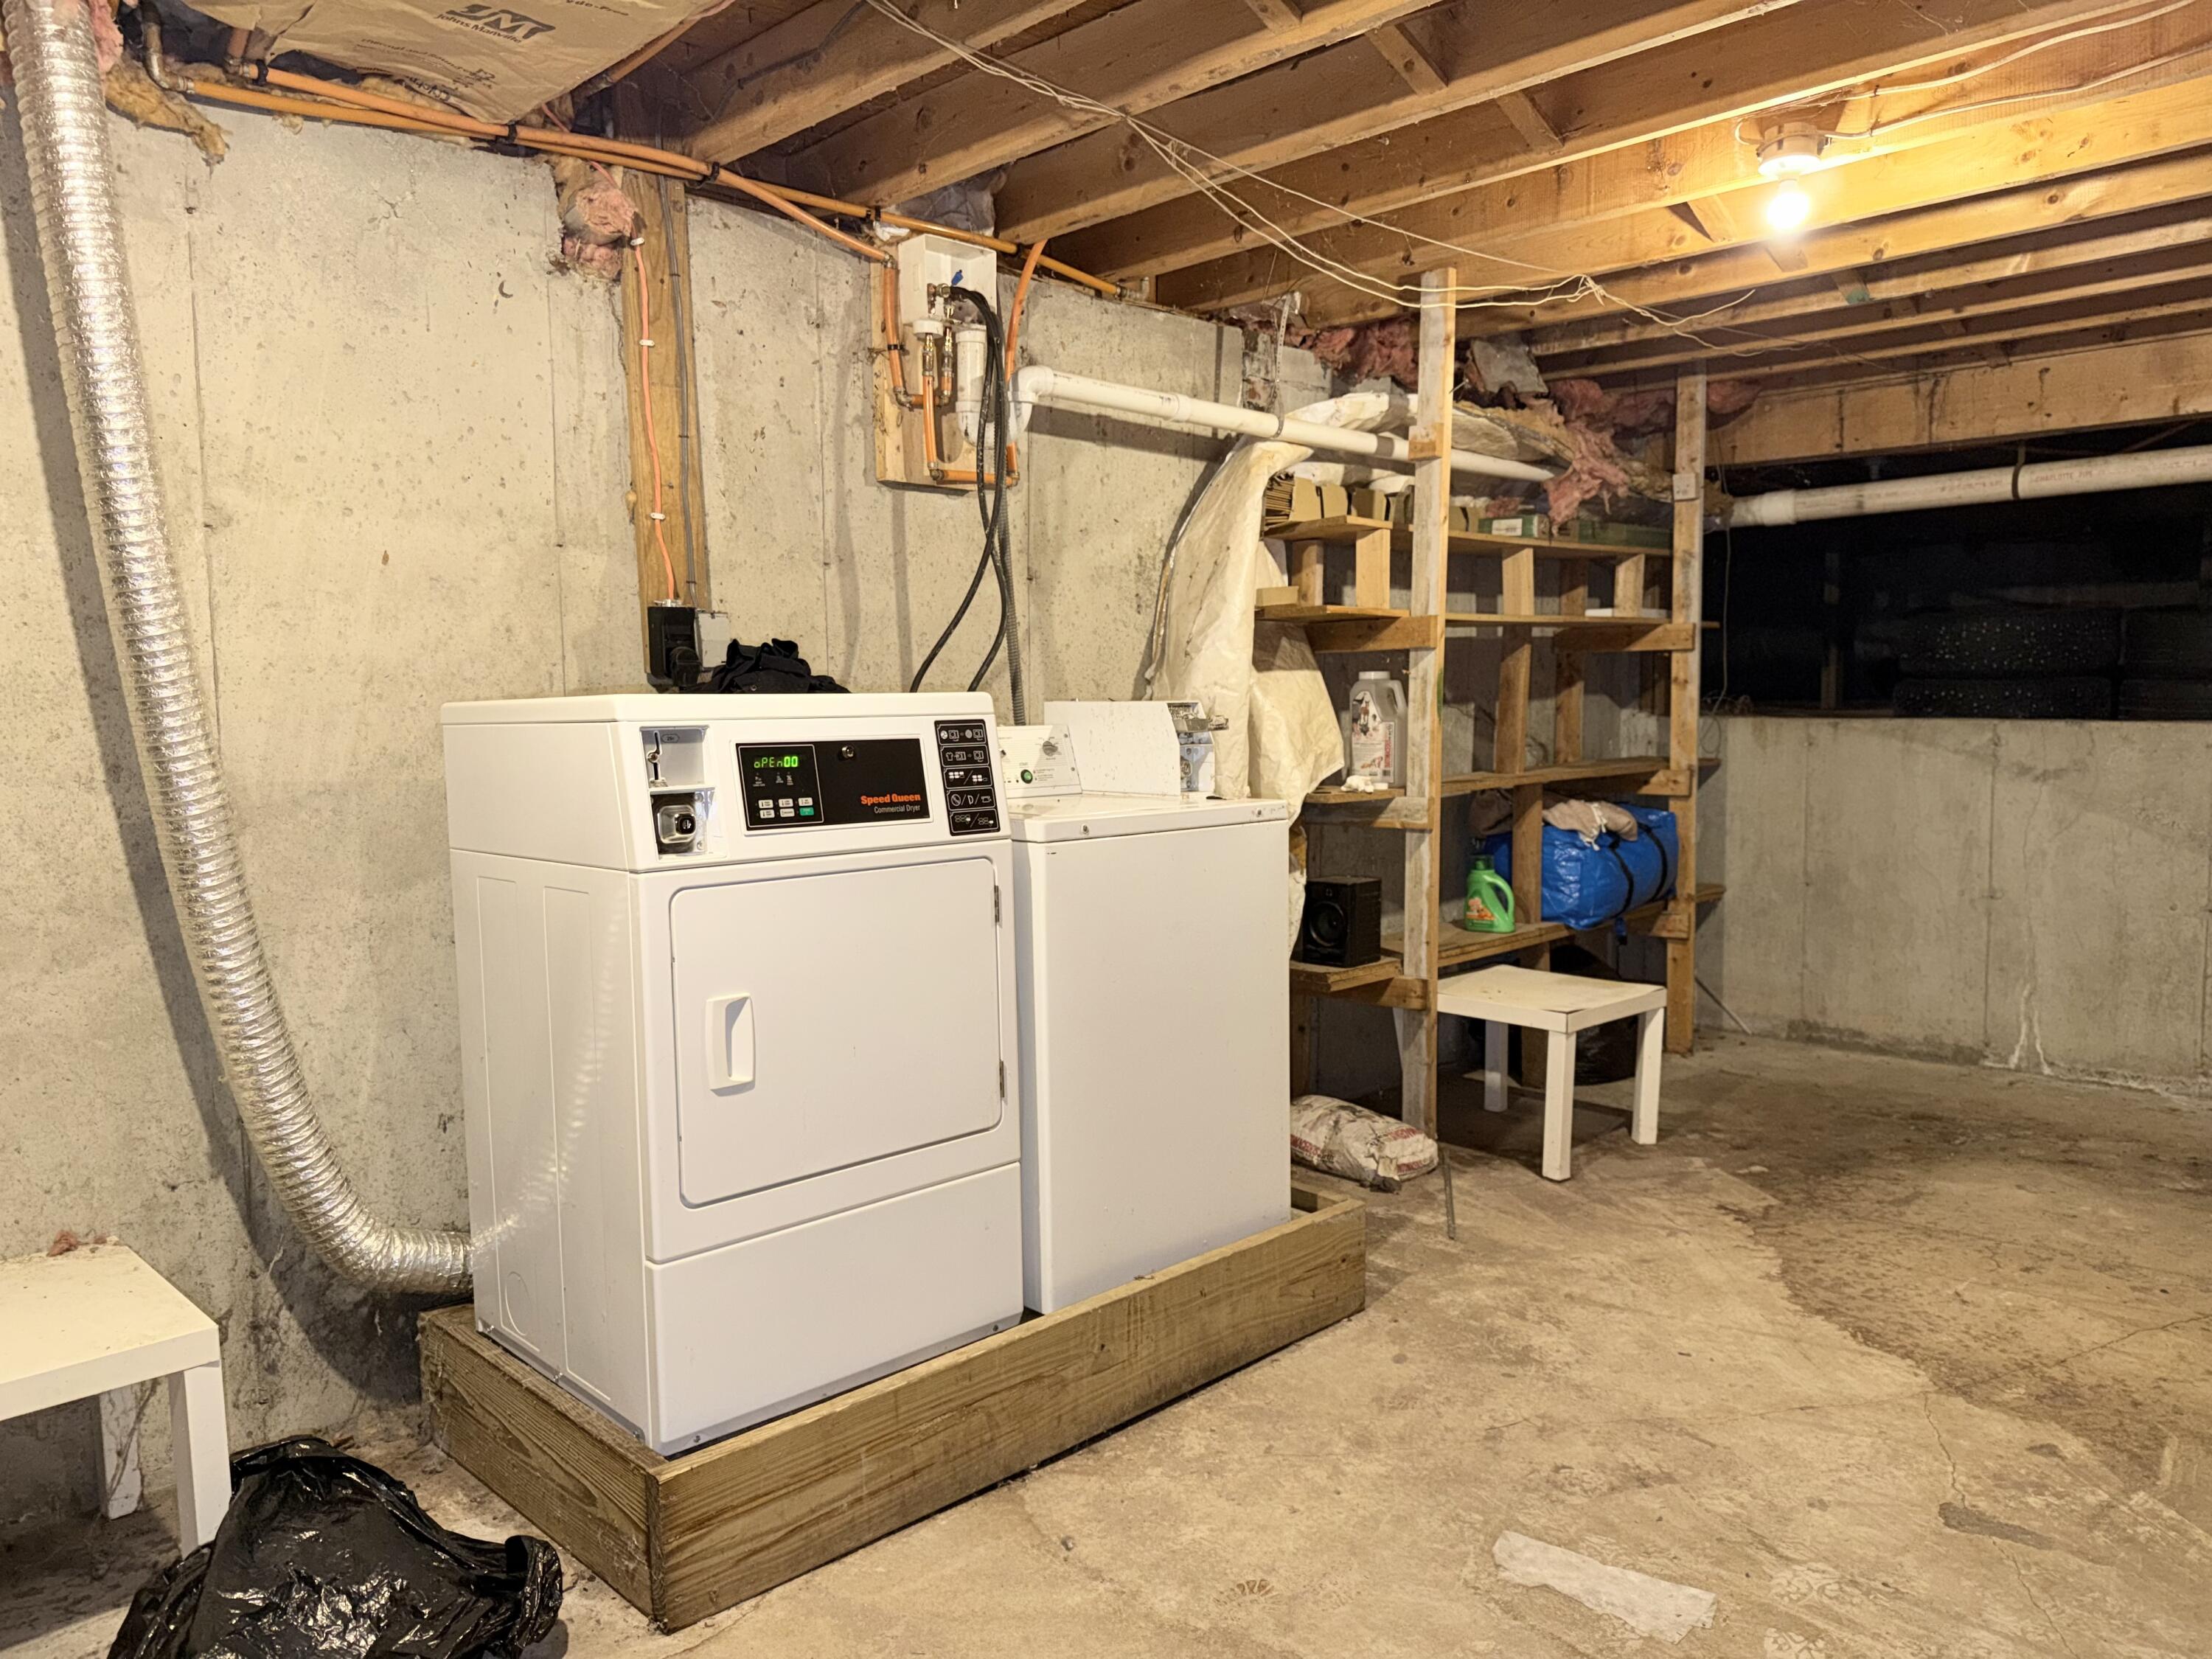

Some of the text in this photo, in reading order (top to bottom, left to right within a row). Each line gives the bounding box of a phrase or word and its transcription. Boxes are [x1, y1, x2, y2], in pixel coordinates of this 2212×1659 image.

[435, 13, 522, 44] Johns Manville
[445, 4, 556, 38] JM
[860, 793, 921, 806] Speed Queen
[874, 804, 920, 814] Commercial Dryer
